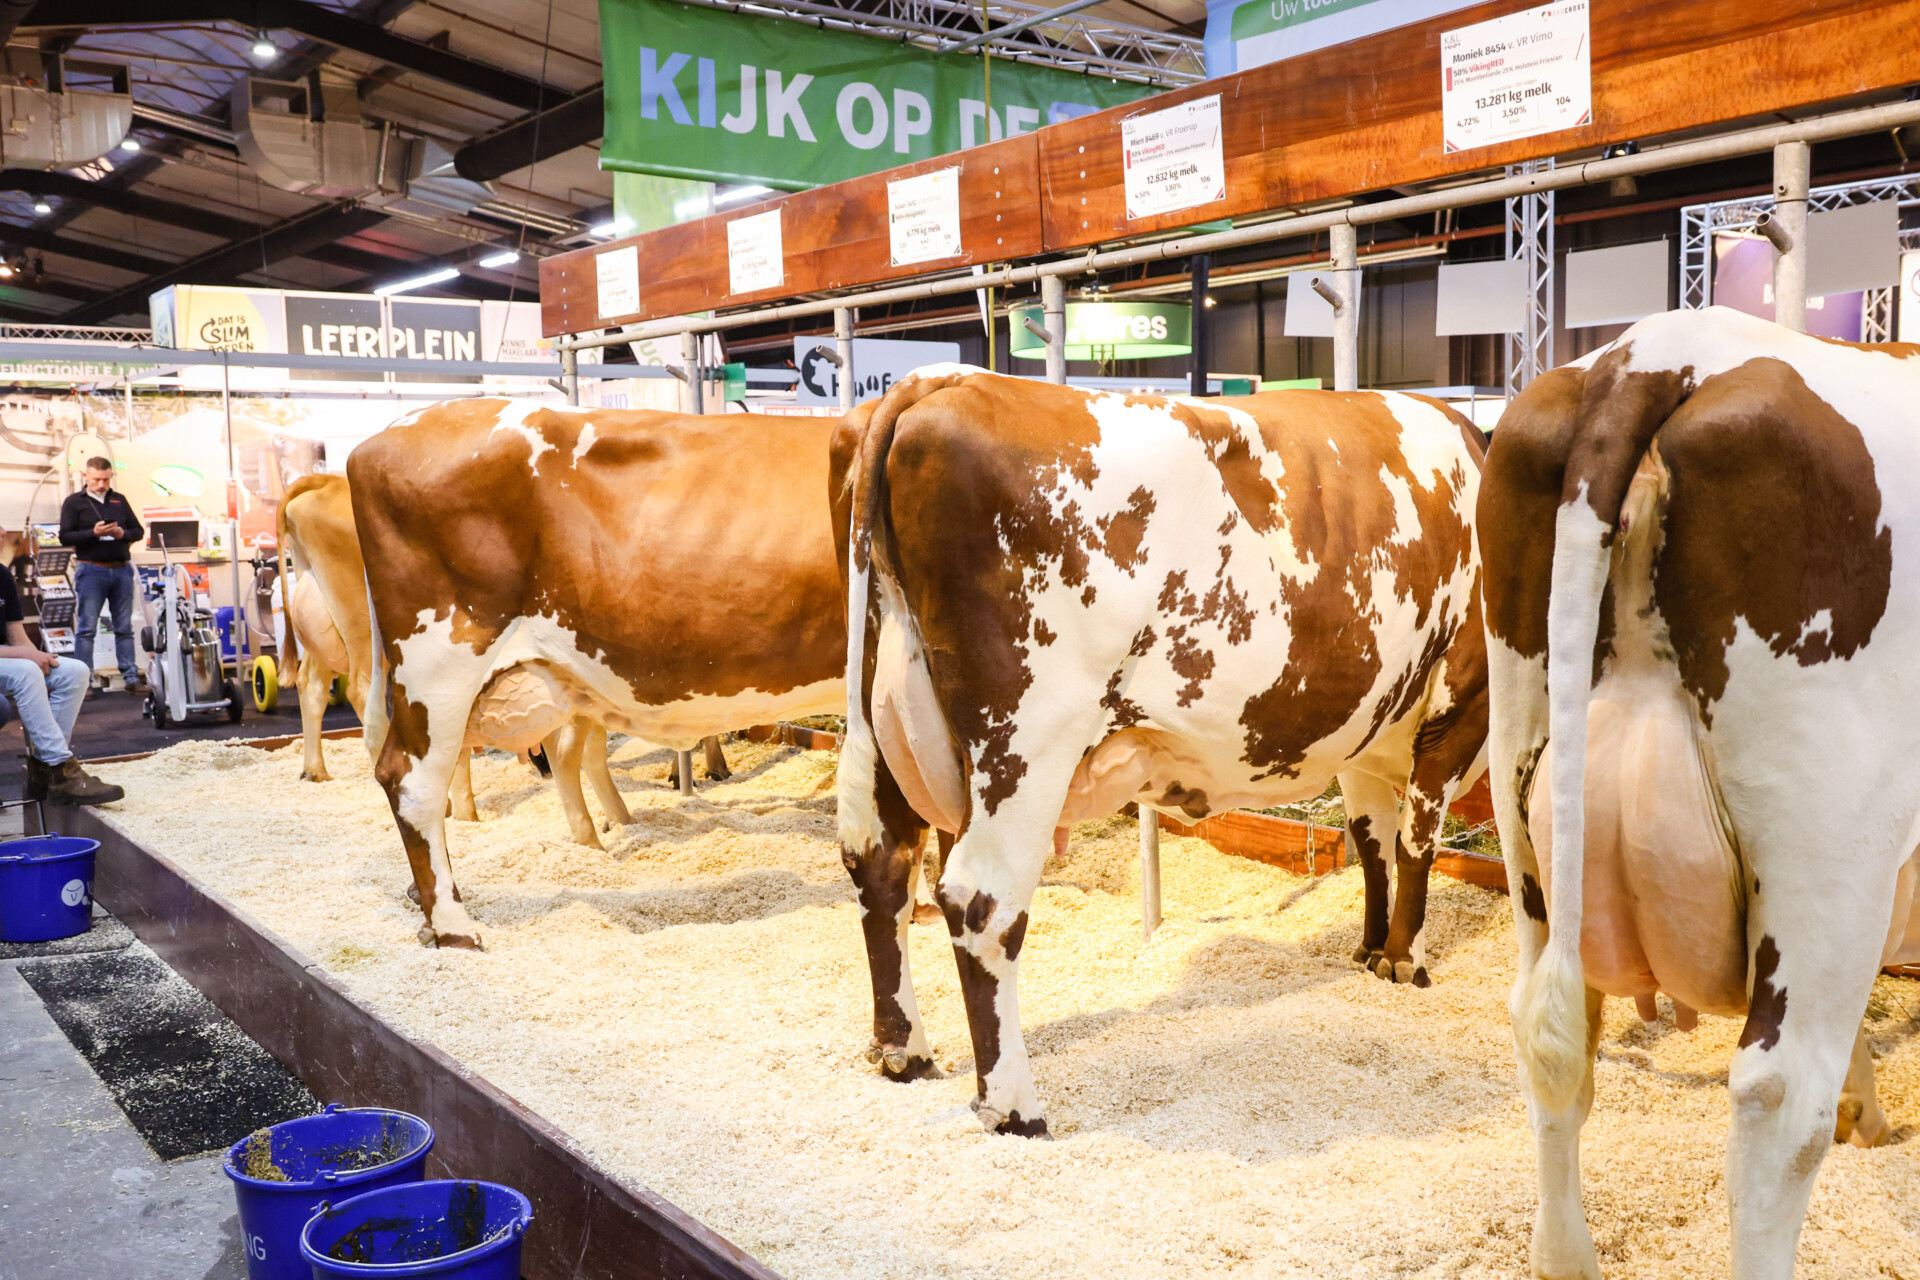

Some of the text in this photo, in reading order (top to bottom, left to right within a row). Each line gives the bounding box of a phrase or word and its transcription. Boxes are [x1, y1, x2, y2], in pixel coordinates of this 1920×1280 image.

[1272, 0, 1298, 20] Uw
[1453, 31, 1553, 63] Moniek 8454 v. VR Vimo
[1453, 58, 1504, 77] 50% VikingRED
[1515, 60, 1539, 71] Holstein
[1539, 54, 1563, 65] Friesian
[639, 46, 817, 143] KIJK
[835, 81, 933, 154] OP
[1475, 82, 1552, 109] 13.281 kg melk
[1555, 95, 1571, 106] 104
[1502, 106, 1527, 118] 3,50%
[1456, 117, 1480, 128] 4,72%
[1130, 136, 1144, 147] Mien
[1145, 132, 1160, 142] 8469
[1165, 128, 1173, 137] VR
[1131, 143, 1166, 158] 50% VikingRED
[1146, 171, 1168, 185] 12.832
[1169, 169, 1179, 180] kg
[1179, 164, 1198, 177] melk
[1200, 175, 1211, 183] 106
[218, 315, 246, 324] DAT IS
[207, 326, 249, 343] SLIM
